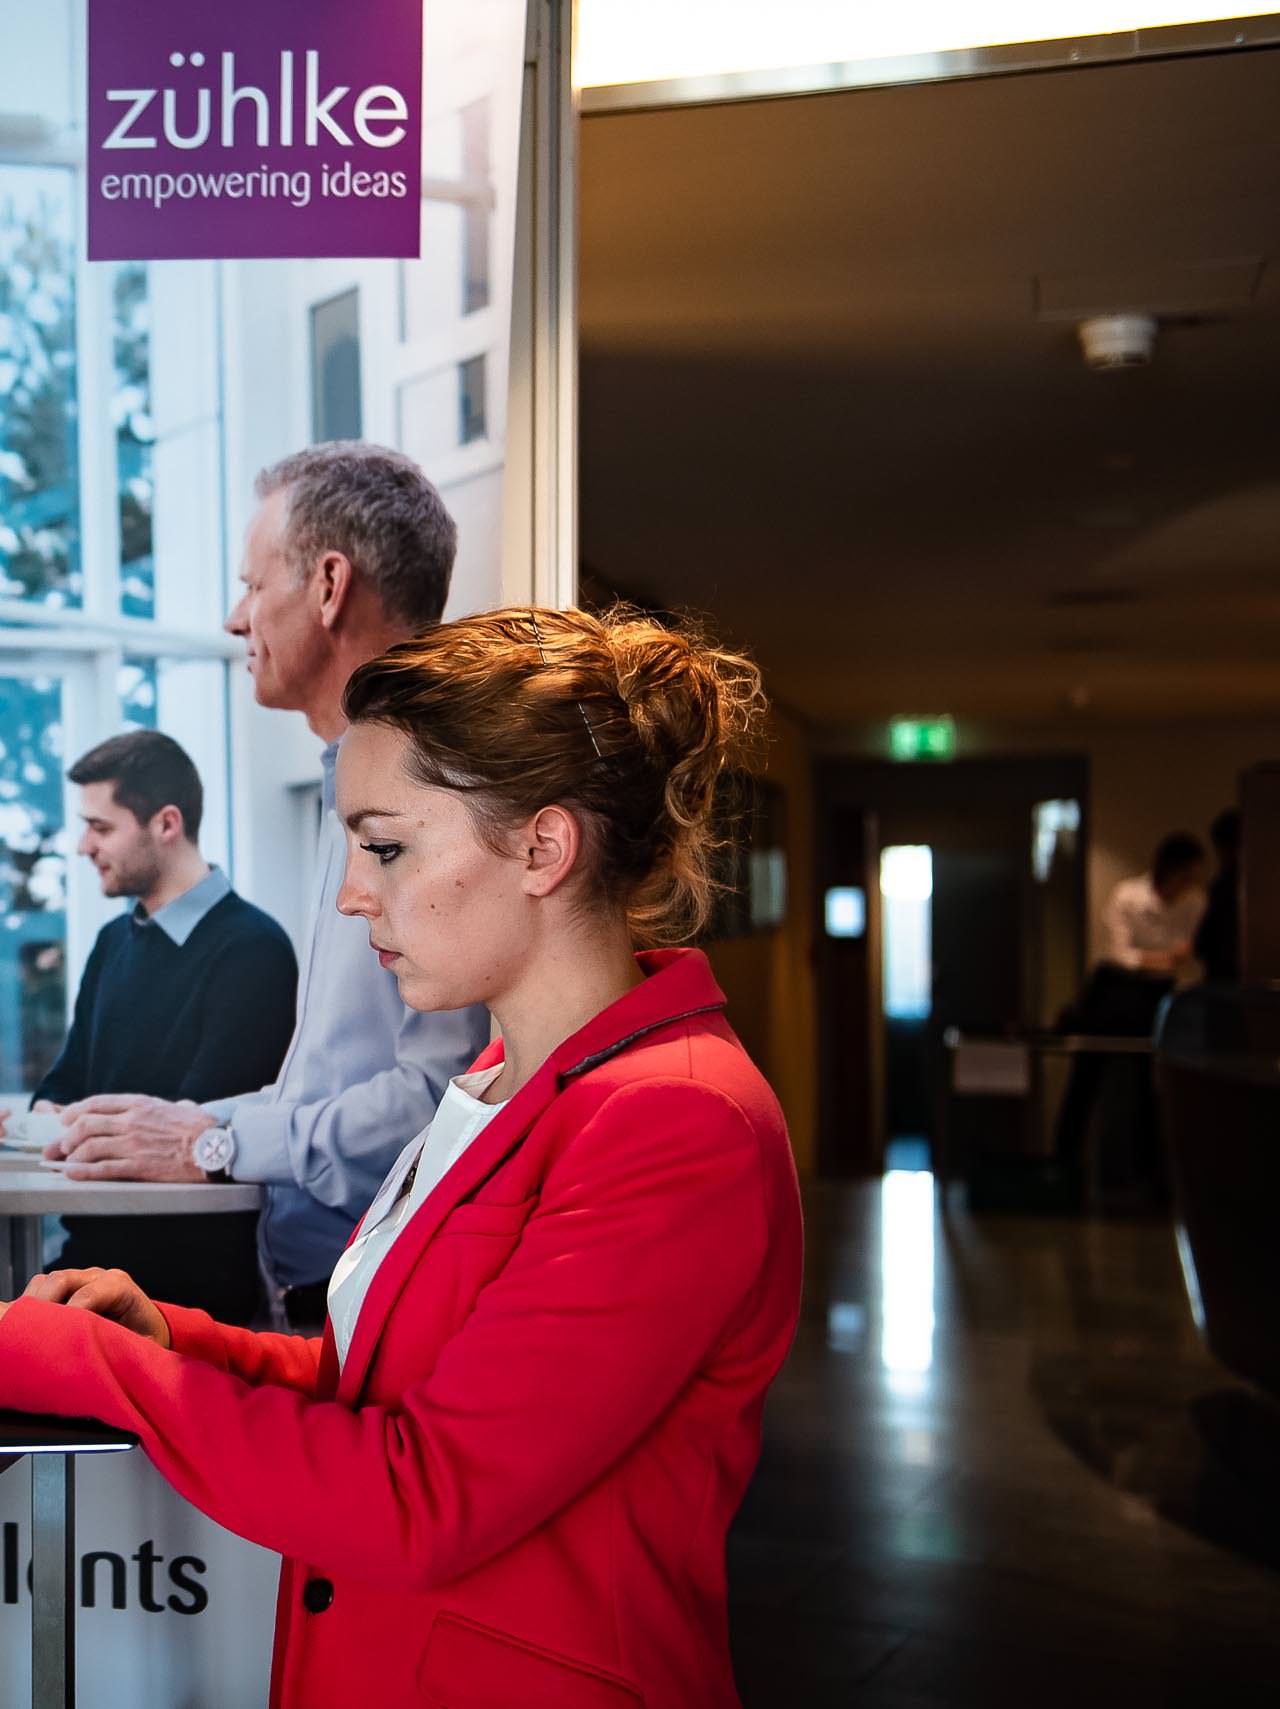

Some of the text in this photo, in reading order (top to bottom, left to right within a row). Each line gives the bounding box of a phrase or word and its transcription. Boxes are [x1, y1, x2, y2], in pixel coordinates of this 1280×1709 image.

[101, 49, 409, 149] zühlke
[100, 161, 407, 208] empowering ideas
